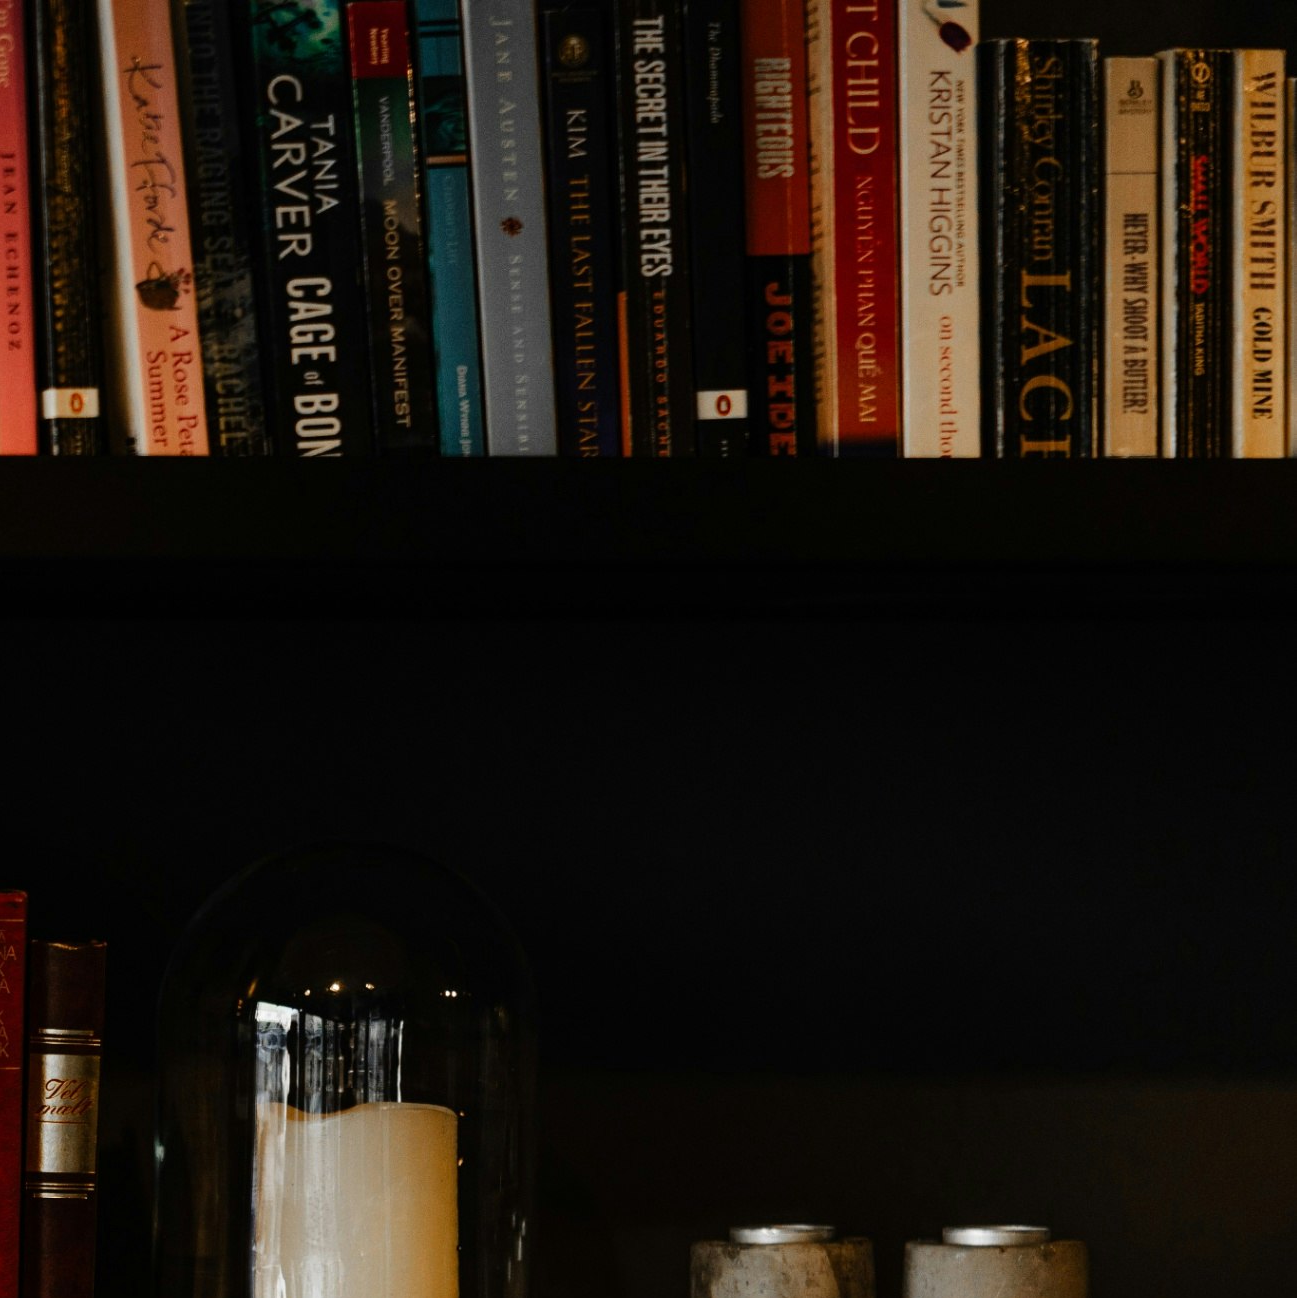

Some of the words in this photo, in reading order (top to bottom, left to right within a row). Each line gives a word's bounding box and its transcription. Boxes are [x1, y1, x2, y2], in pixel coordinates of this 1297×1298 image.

[488, 15, 514, 82] JANE
[632, 15, 665, 56] THE
[707, 21, 722, 42] The
[634, 59, 669, 137] SECRET
[753, 57, 795, 180] RIGHTEOUS
[845, 31, 881, 155] CHILD
[1031, 55, 1064, 148] Shirley
[378, 95, 395, 187] VANDERPOOL
[498, 99, 519, 201] AUSTEN
[566, 108, 588, 159] KIM
[636, 141, 669, 162] IN
[928, 70, 952, 179] KRISTAN
[1249, 71, 1277, 190] WILBUR
[267, 74, 313, 261] CARVER
[310, 113, 341, 215] TANIA
[637, 164, 671, 223] THEIR
[383, 199, 401, 260] MOON
[567, 174, 591, 226] THE
[1031, 156, 1063, 261] Conran
[571, 234, 595, 293] LAST
[639, 228, 674, 278] EYES
[928, 188, 953, 297] HIGGINS
[1122, 212, 1149, 256] HEYER
[1190, 216, 1210, 295] WORLD
[1249, 199, 1277, 290] SMITH
[3, 232, 22, 351] ECHENOZ
[386, 266, 404, 321] OVER
[508, 254, 524, 314] SENSE
[857, 269, 877, 327] PHAN
[1122, 261, 1149, 293] WHY
[168, 323, 190, 342] A
[285, 276, 337, 366] CAGE
[512, 326, 525, 364] AND
[573, 302, 598, 391] FALLEN
[652, 290, 669, 384] EDUARDO
[764, 279, 795, 365] JOE
[939, 315, 953, 341] on
[1122, 297, 1149, 342] SHOOT
[1252, 306, 1273, 363] GOLD
[170, 350, 194, 407] Rose
[389, 324, 411, 428] MANIFEST
[939, 346, 958, 415] second
[1123, 345, 1148, 359] A
[1193, 347, 1206, 377] KING
[146, 350, 169, 447] Summer
[766, 373, 797, 458] IDE
[858, 384, 878, 423] MAI
[1121, 358, 1149, 415] BUTLER?
[1252, 369, 1273, 420] MINE
[576, 400, 600, 458] STAR
[44, 1077, 89, 1102] Vel
